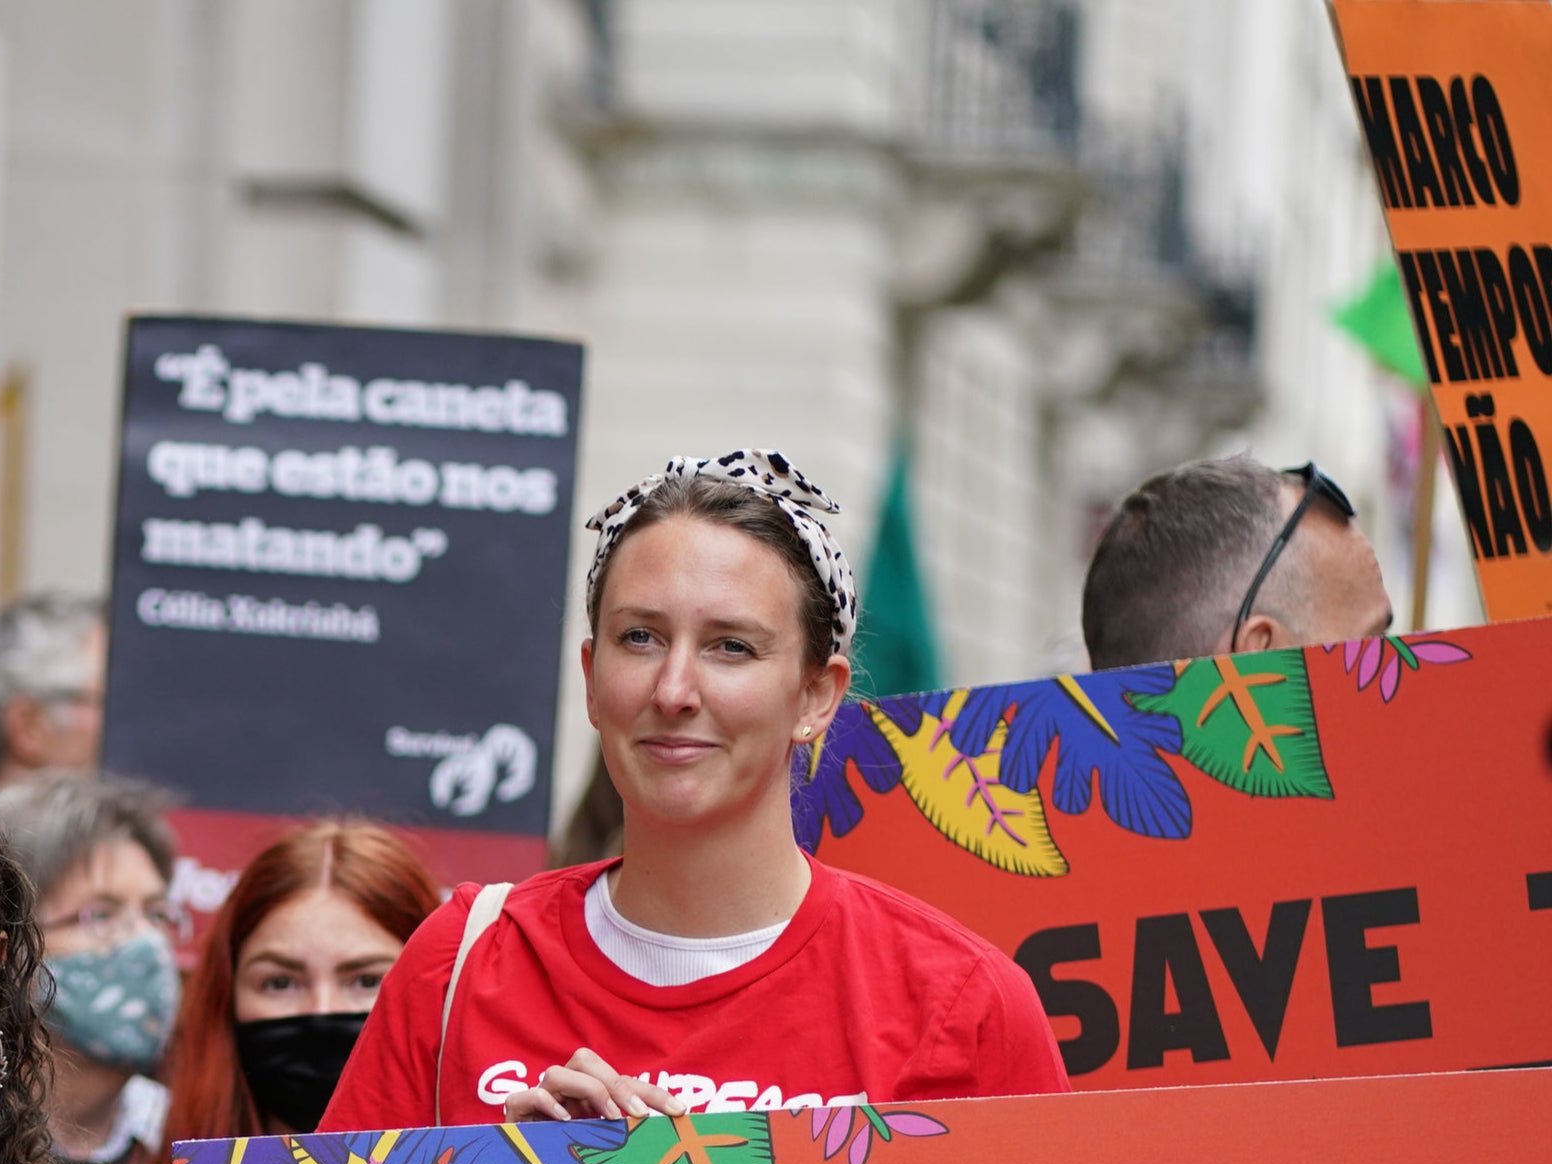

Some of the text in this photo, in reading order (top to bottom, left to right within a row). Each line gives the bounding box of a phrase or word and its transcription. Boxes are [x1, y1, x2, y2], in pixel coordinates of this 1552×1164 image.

[1349, 74, 1521, 209] MARCO
[1397, 241, 1552, 384] EMPO
[223, 361, 361, 424] pela
[363, 378, 569, 436] caneta
[148, 440, 558, 514] que estão nos
[1444, 392, 1552, 560] NÃO
[1014, 887, 1433, 1076] SAVE
